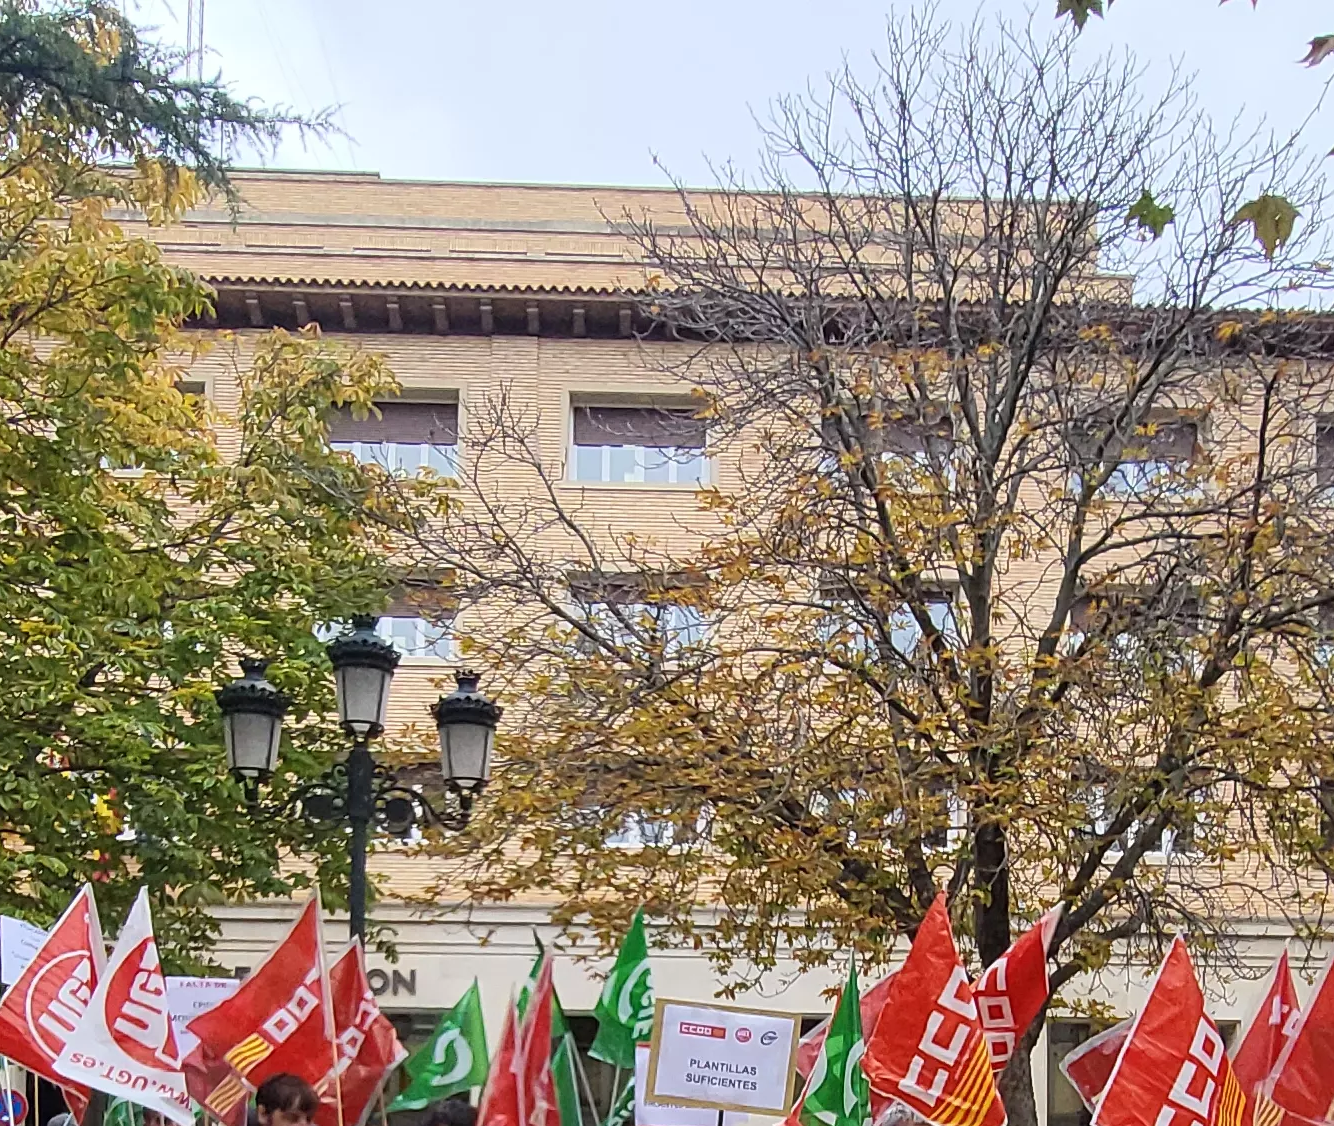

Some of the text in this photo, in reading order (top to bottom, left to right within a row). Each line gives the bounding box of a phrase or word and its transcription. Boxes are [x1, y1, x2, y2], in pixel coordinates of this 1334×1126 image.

[977, 946, 1016, 1064] COO
[680, 1023, 712, 1036] CCOO
[898, 964, 978, 1108] CCO
[70, 1052, 193, 1111] ww.UGT.es
[685, 1073, 757, 1091] SUFICIENTES
[689, 1058, 757, 1076] PLANTILLAS
